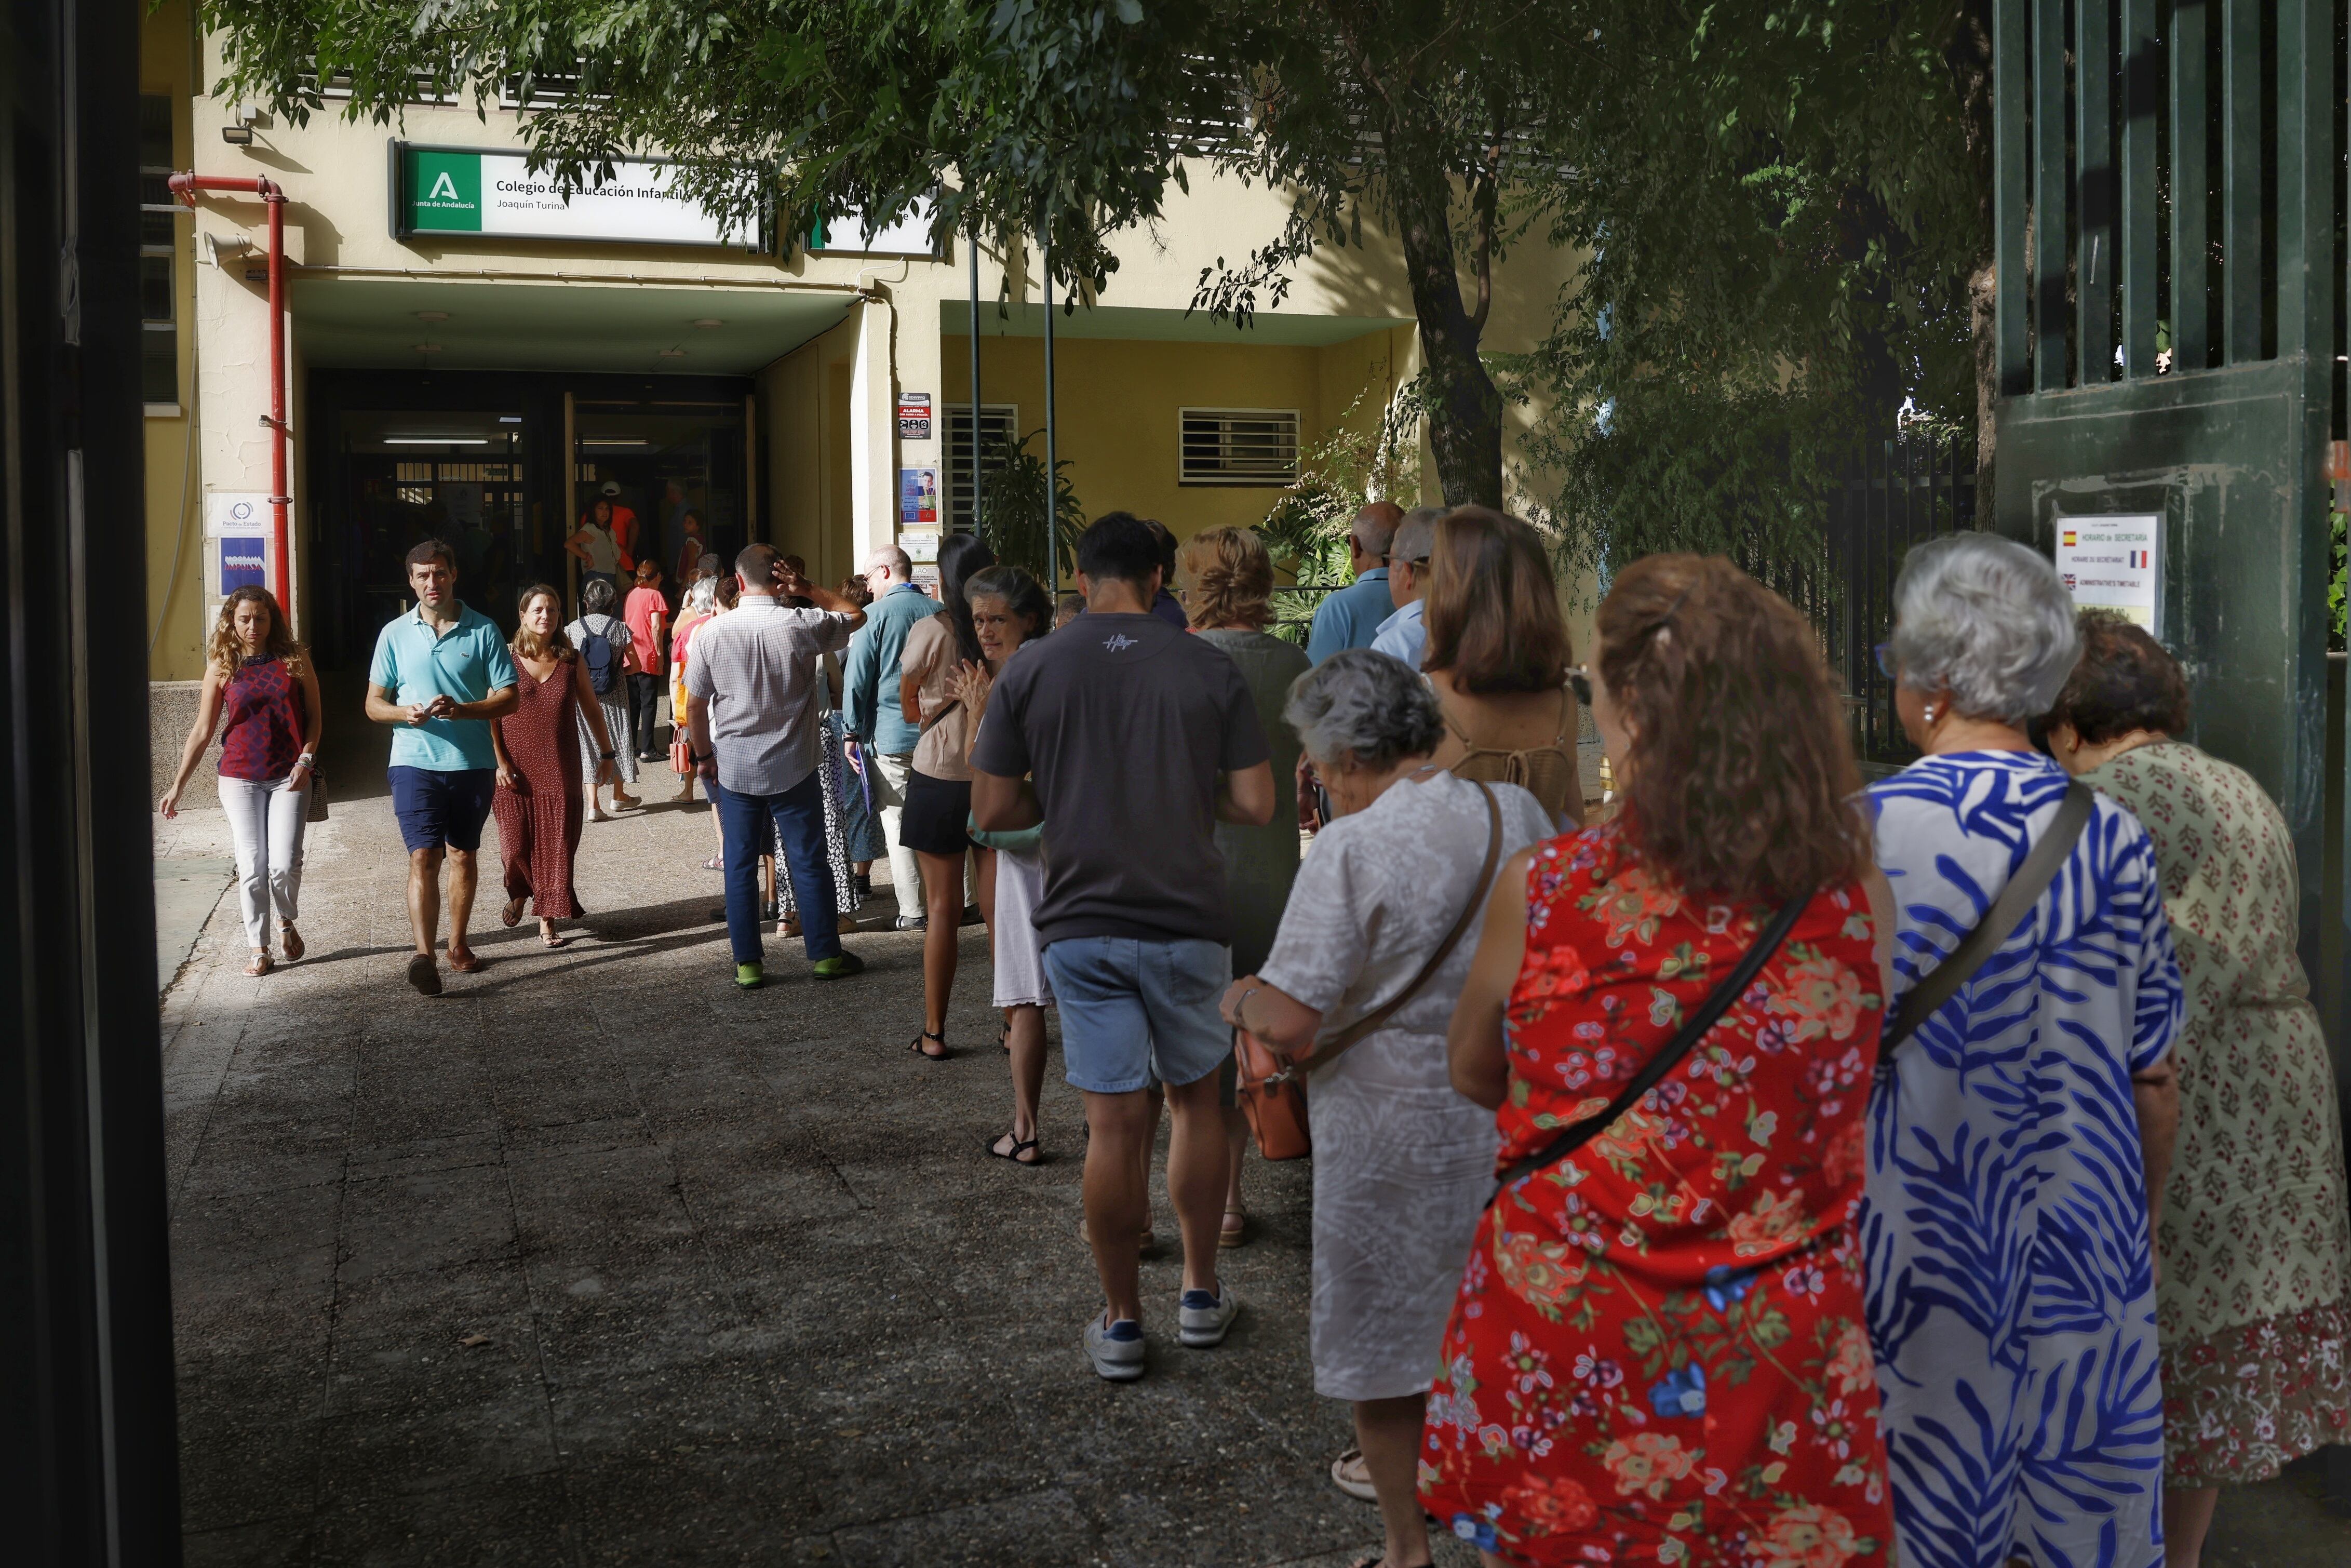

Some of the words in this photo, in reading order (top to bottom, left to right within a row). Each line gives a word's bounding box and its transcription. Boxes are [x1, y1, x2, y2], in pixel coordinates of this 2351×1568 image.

[496, 181, 545, 195] Colegio
[549, 183, 564, 194] de
[570, 184, 634, 197] Educación
[497, 199, 533, 210] Joaquín
[536, 202, 565, 210] Turina
